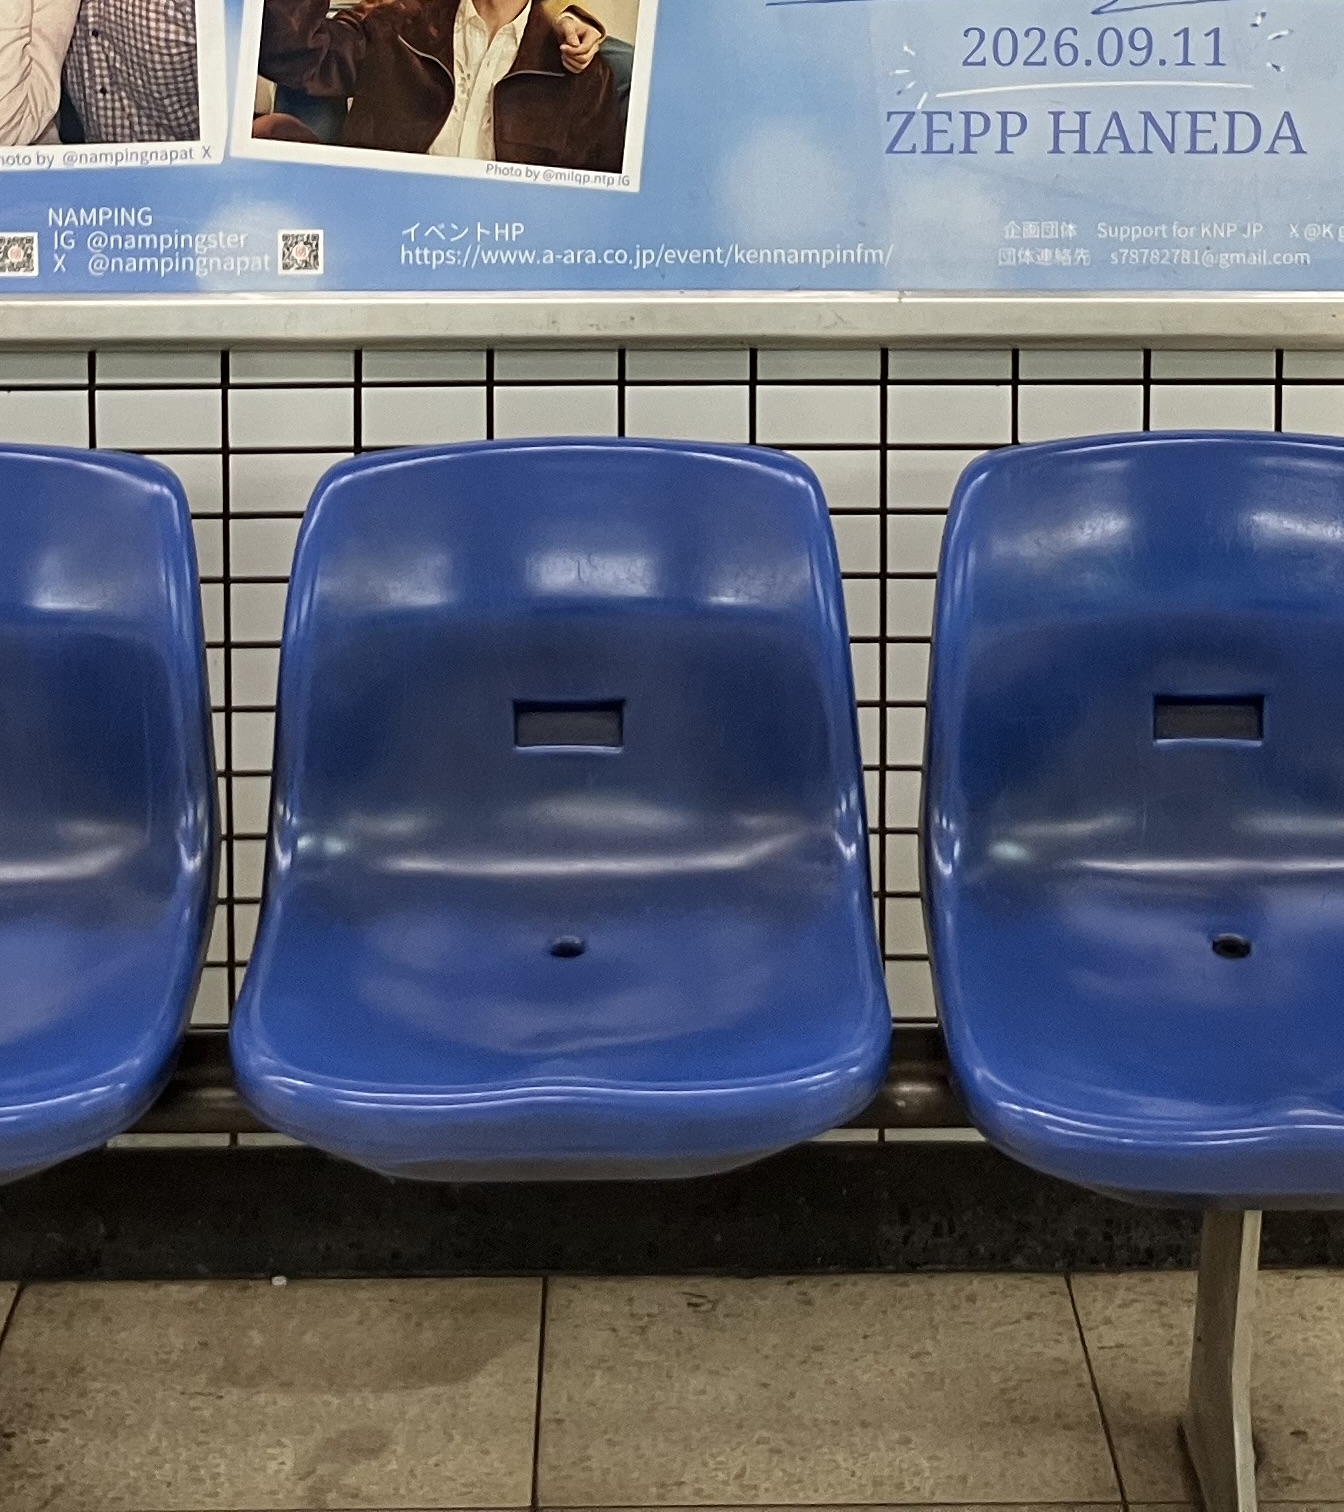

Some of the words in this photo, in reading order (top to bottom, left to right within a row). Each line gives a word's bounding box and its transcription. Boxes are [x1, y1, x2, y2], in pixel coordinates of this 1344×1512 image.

[961, 25, 1228, 68] 2026.09.11
[885, 110, 1029, 156] ZEPP
[1048, 109, 1308, 156] HANEDA
[36, 150, 55, 173] by
[62, 145, 196, 171] @nampingnapat
[202, 145, 213, 162] X
[485, 162, 523, 179] Photo
[525, 166, 541, 182] by
[48, 207, 153, 227] NAMPING
[401, 222, 525, 243] イベントHP
[1097, 222, 1167, 242] Support
[1172, 221, 1195, 238] for
[1200, 222, 1237, 238] KNP
[1242, 222, 1263, 239] JP
[1289, 223, 1300, 238] X
[53, 231, 76, 251] IG
[87, 229, 249, 257] @nampingster
[53, 254, 67, 274] X
[88, 251, 271, 280] @nampingnapat
